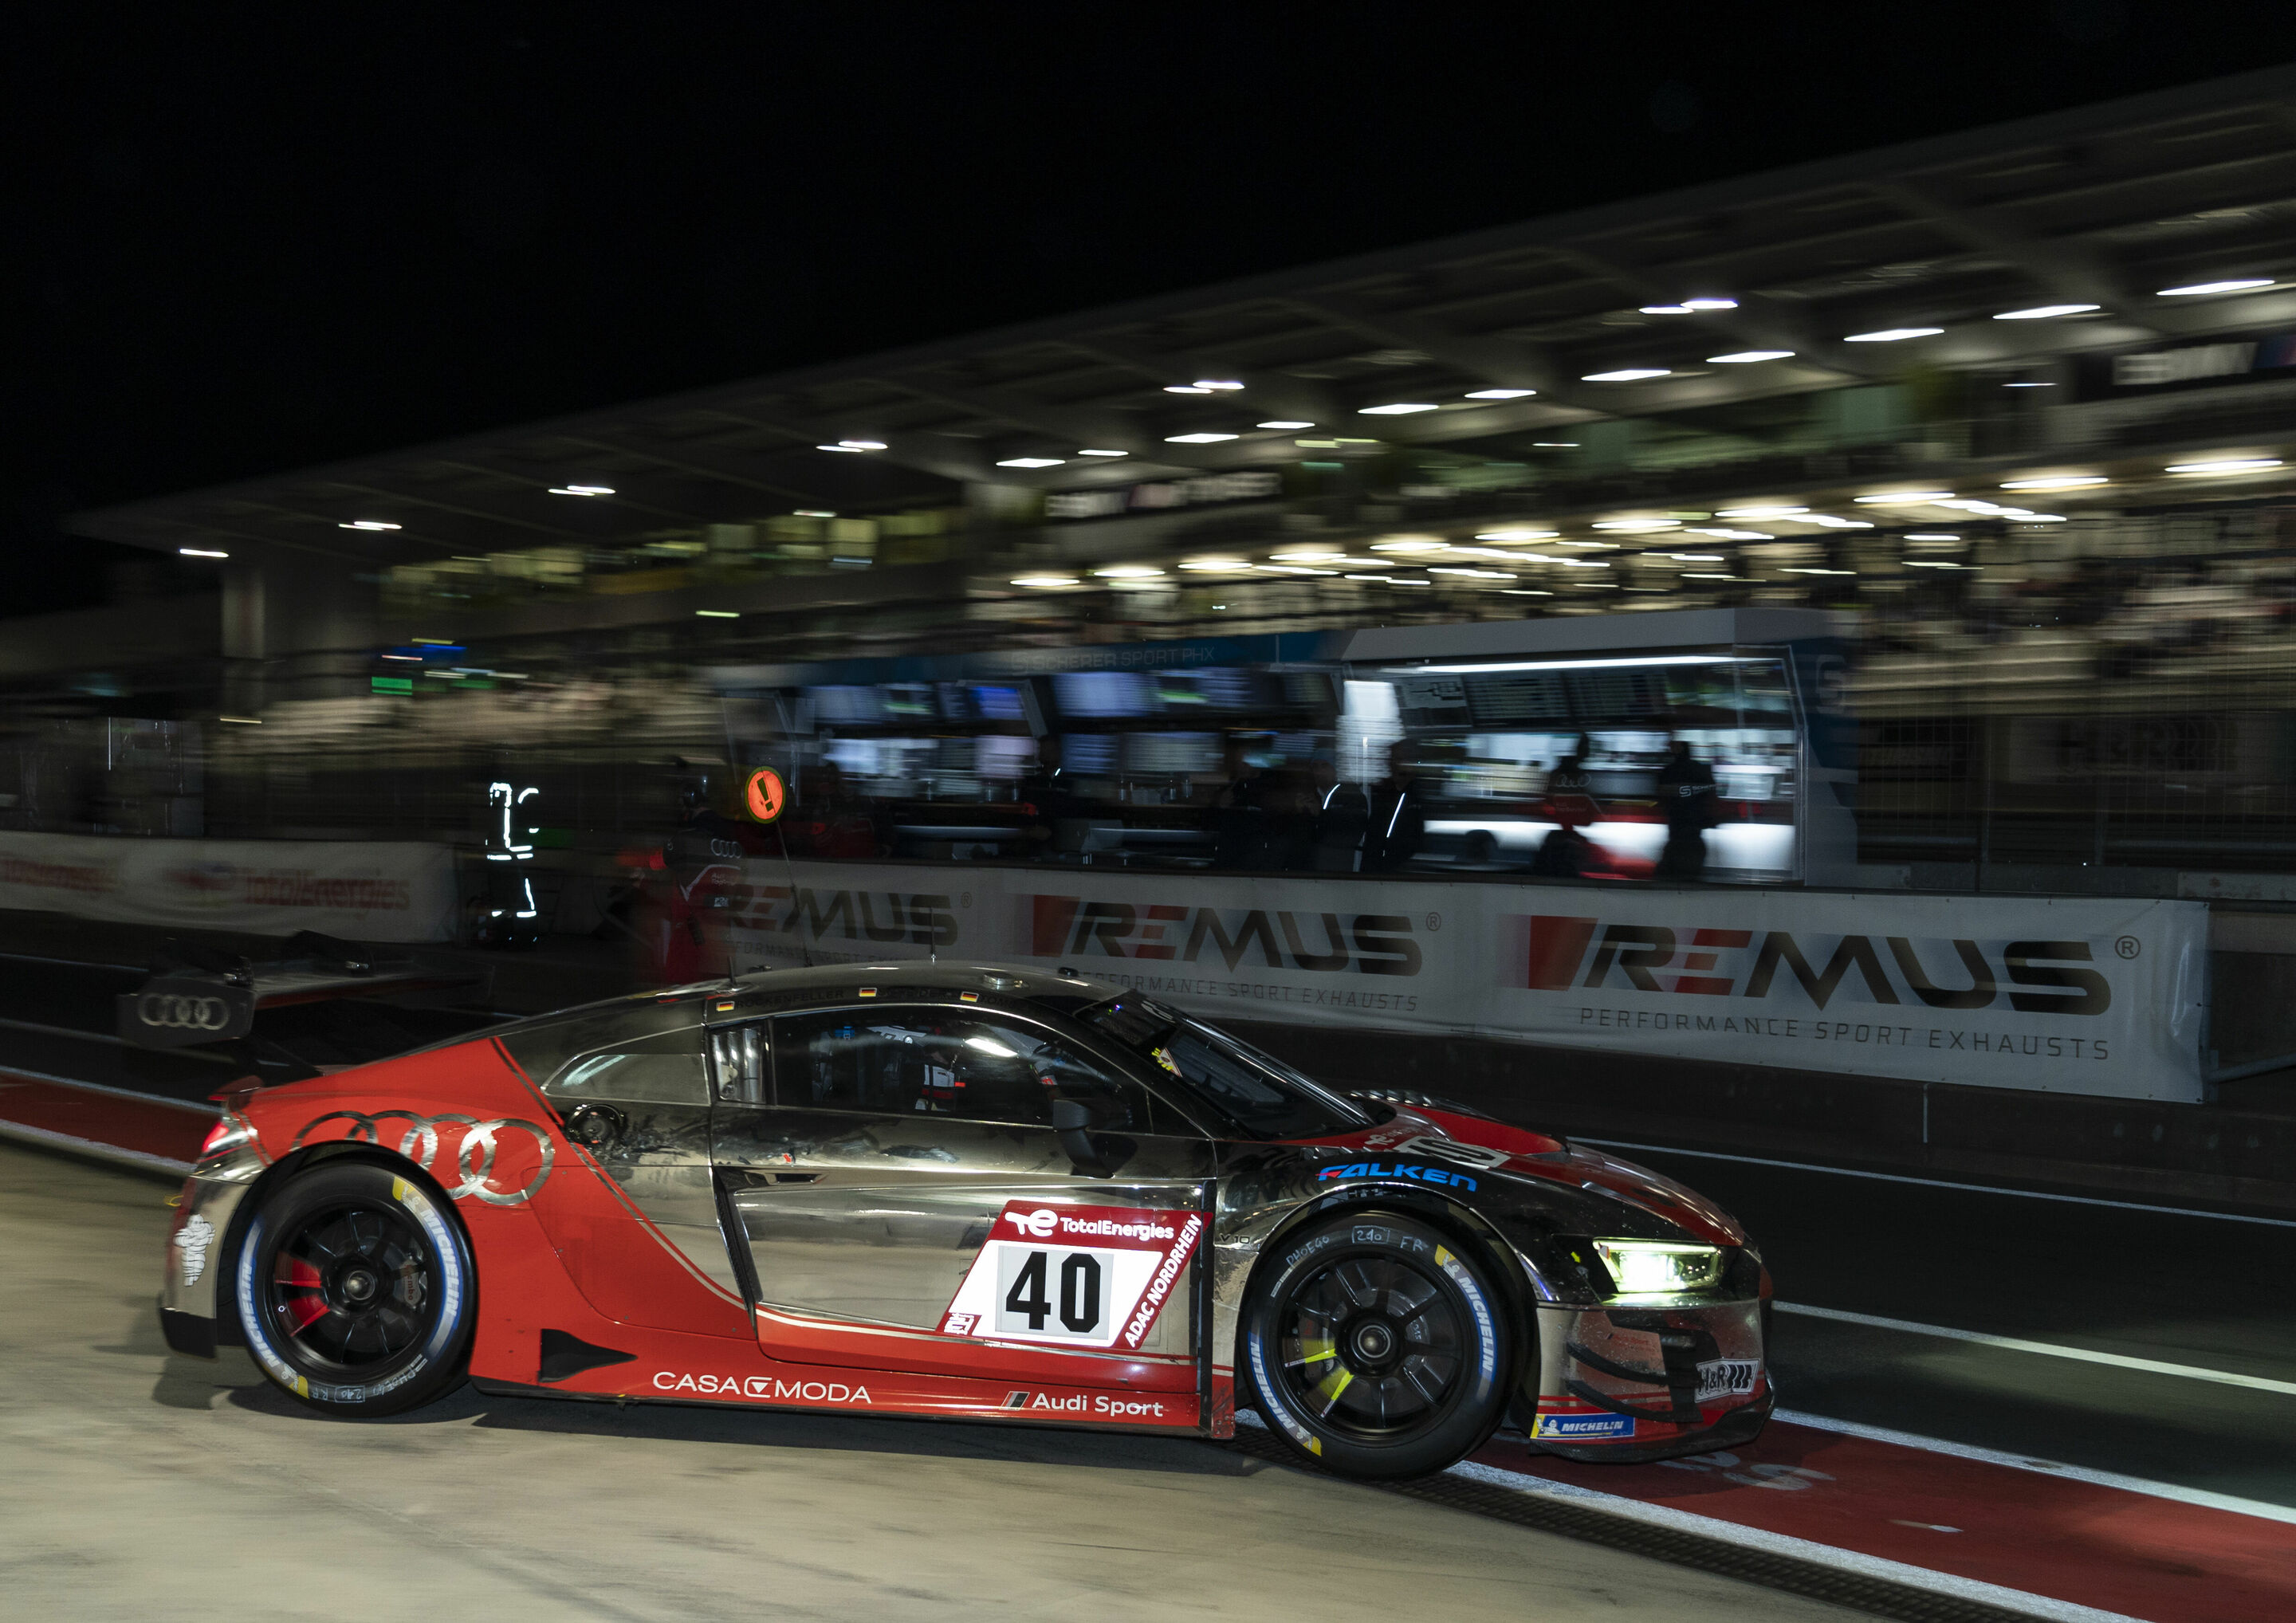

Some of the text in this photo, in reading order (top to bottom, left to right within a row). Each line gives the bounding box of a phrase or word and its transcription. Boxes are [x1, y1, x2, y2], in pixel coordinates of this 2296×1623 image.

[1121, 648, 1178, 666] SPORT
[1181, 645, 1216, 663] PHX
[1071, 901, 1423, 977] REMUS
[1583, 925, 2113, 1016] REMUS
[1229, 982, 1292, 1003] SPORT
[1302, 988, 1419, 1012] EXHAUSTS
[1579, 1008, 2109, 1061] PERFORMANCE SPORT EXHAUSTS
[1316, 1161, 1479, 1193] FALKEN
[423, 1208, 460, 1317] MICHELIN
[1060, 1216, 1175, 1242] TotalEnergies
[241, 1263, 281, 1367] MICHELIN
[1005, 1250, 1102, 1334] 40
[1122, 1213, 1202, 1348] ADAC NORDRHEIN
[1459, 1276, 1494, 1370] MICHELIN
[1032, 1391, 1163, 1418] Audi Sport
[1249, 1341, 1295, 1429] MICHELIN
[1561, 1420, 1624, 1432] MICHELIN
